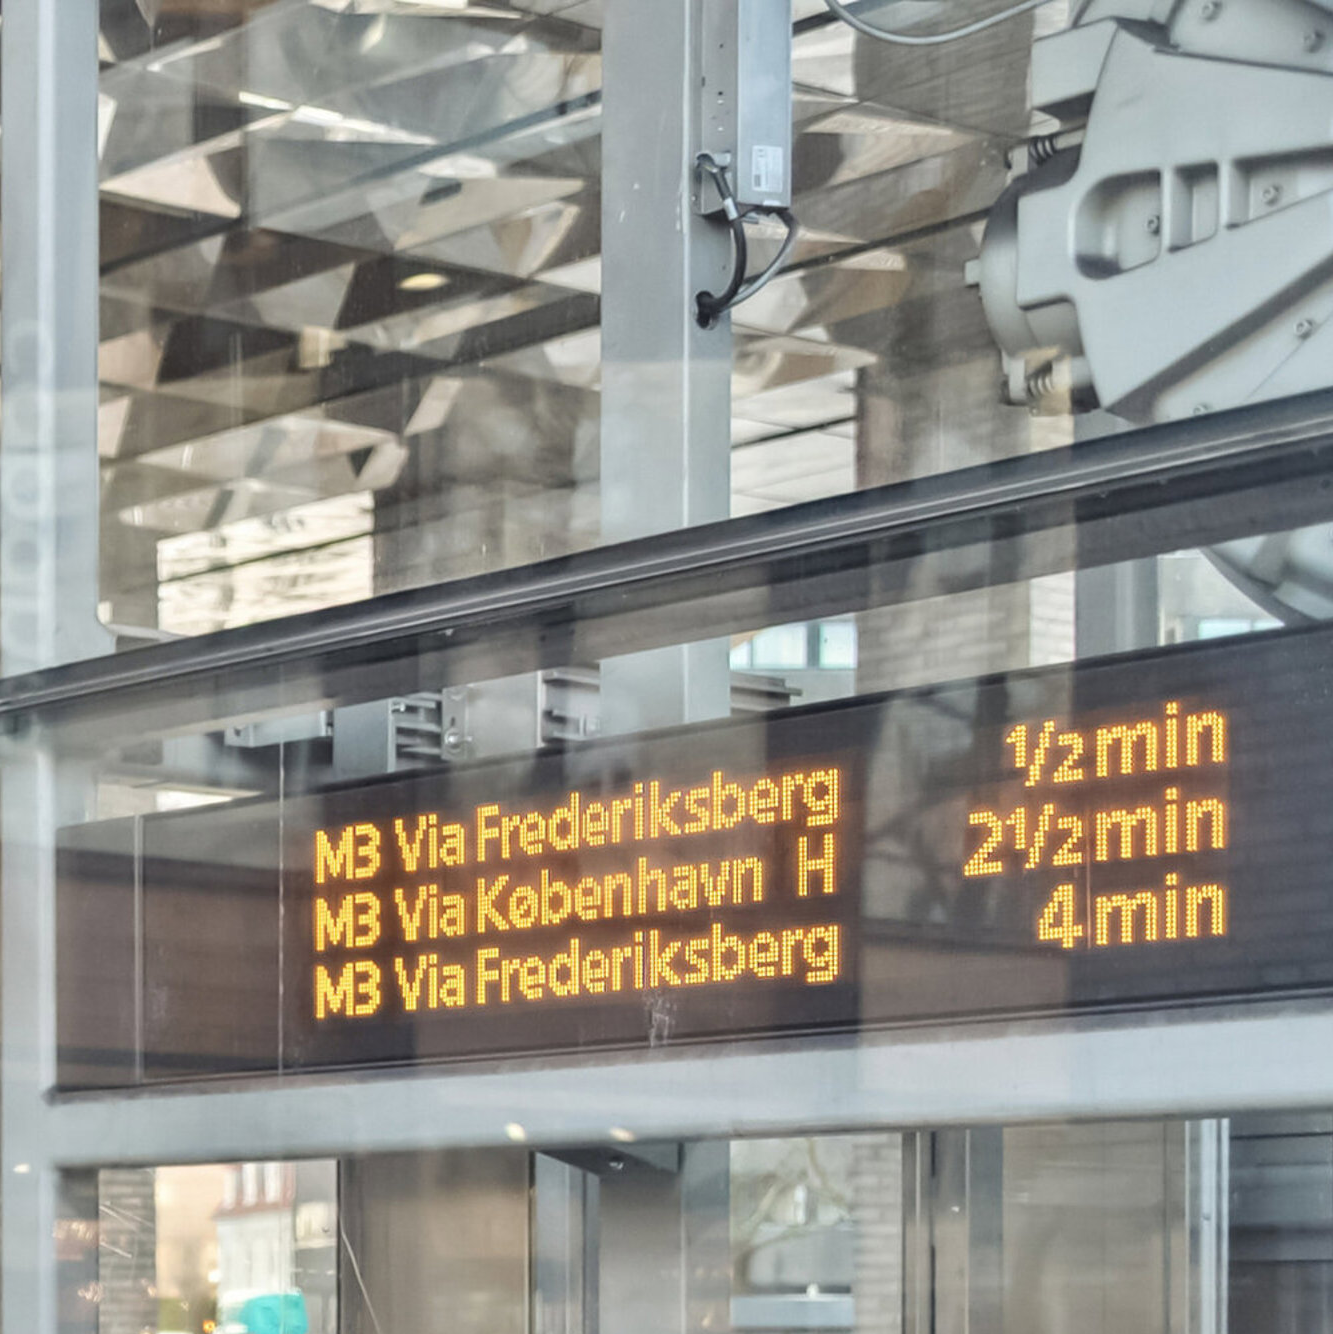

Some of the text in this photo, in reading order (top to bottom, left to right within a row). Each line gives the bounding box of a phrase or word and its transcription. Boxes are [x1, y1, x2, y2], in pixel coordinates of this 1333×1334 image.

[314, 822, 382, 884] M3
[393, 812, 466, 873] Via
[475, 767, 840, 863] Frederiksberg
[1095, 701, 1226, 778] min
[314, 891, 382, 952] M3
[393, 883, 466, 942] Via
[475, 855, 764, 934] København
[797, 831, 835, 897] H
[1095, 786, 1226, 862] min
[314, 871, 1226, 1020] M3 Via Frederiksberg 4 min
